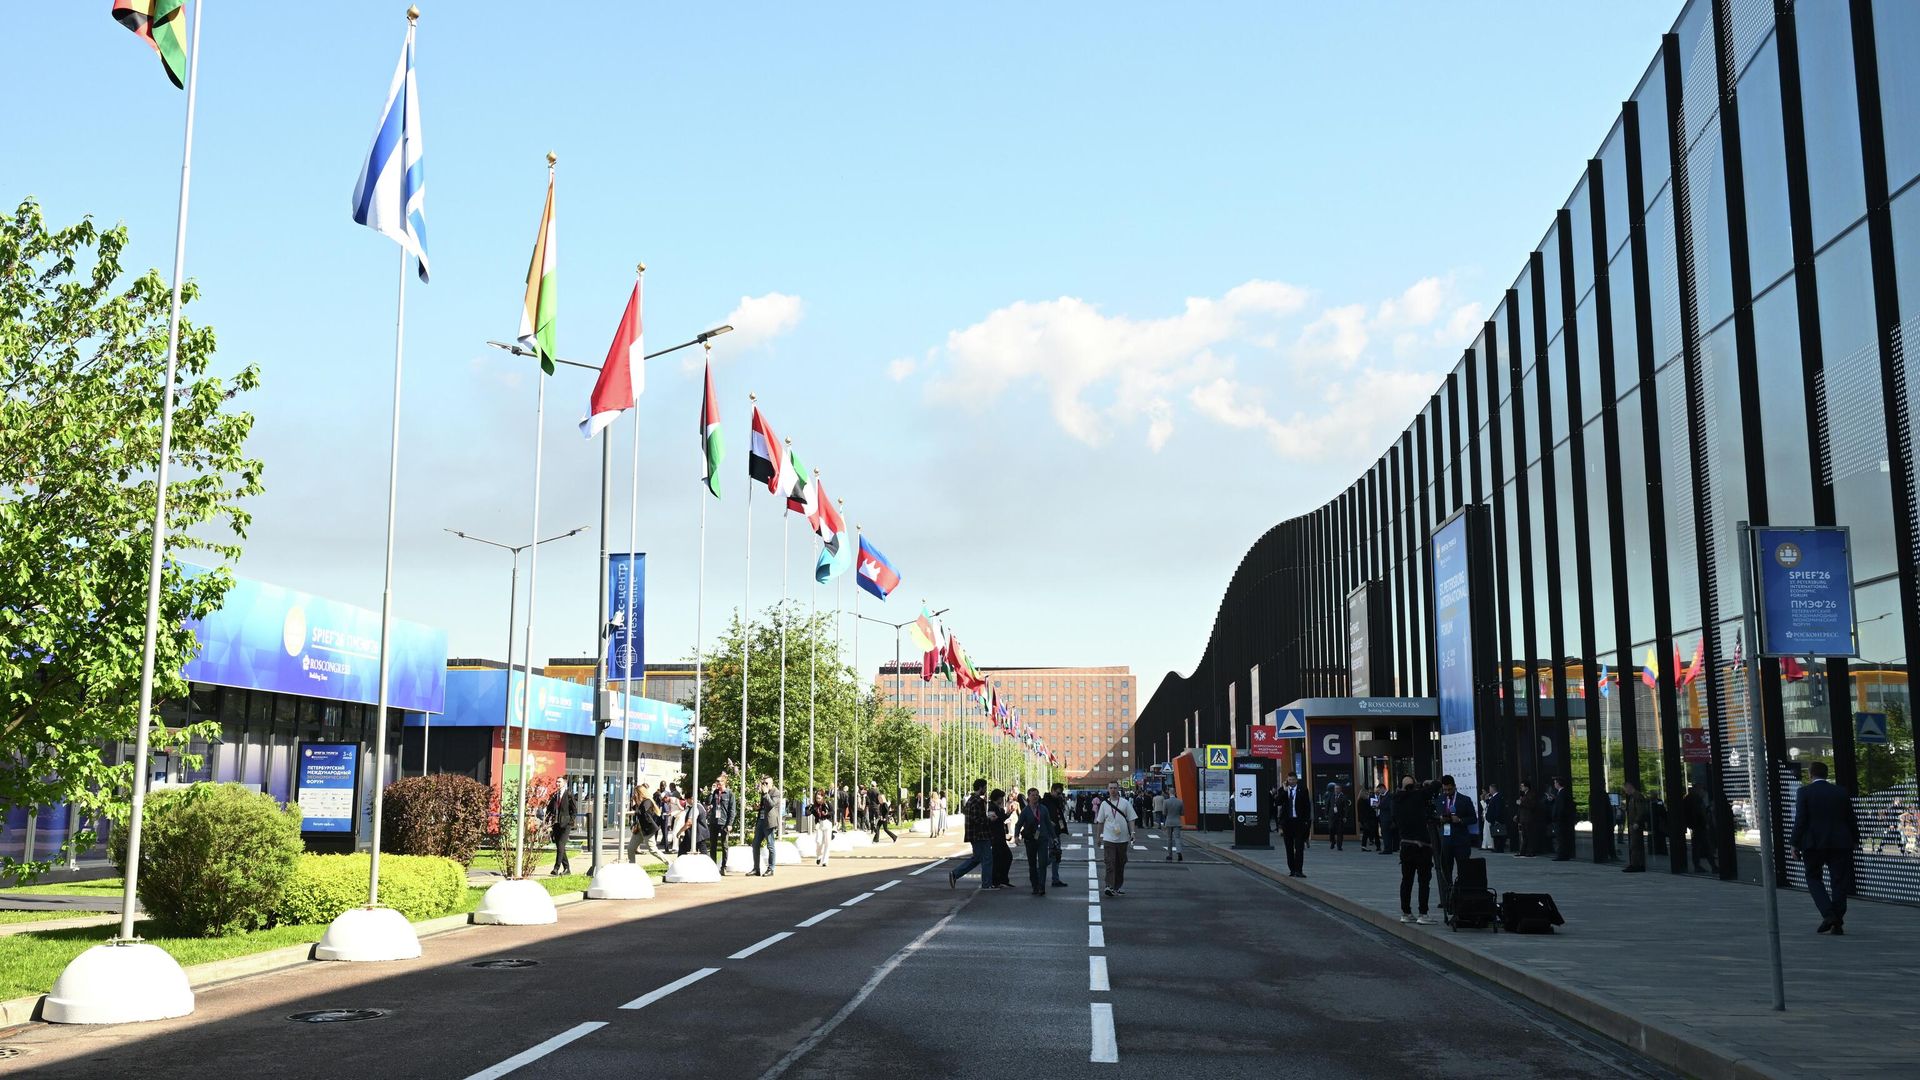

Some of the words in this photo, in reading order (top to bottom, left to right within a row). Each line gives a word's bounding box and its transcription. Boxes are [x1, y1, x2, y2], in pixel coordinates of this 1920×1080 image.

[1789, 571, 1830, 579] SPIEF'26
[1791, 600, 1837, 608] ПМЭФ'26
[1323, 734, 1341, 755] G
